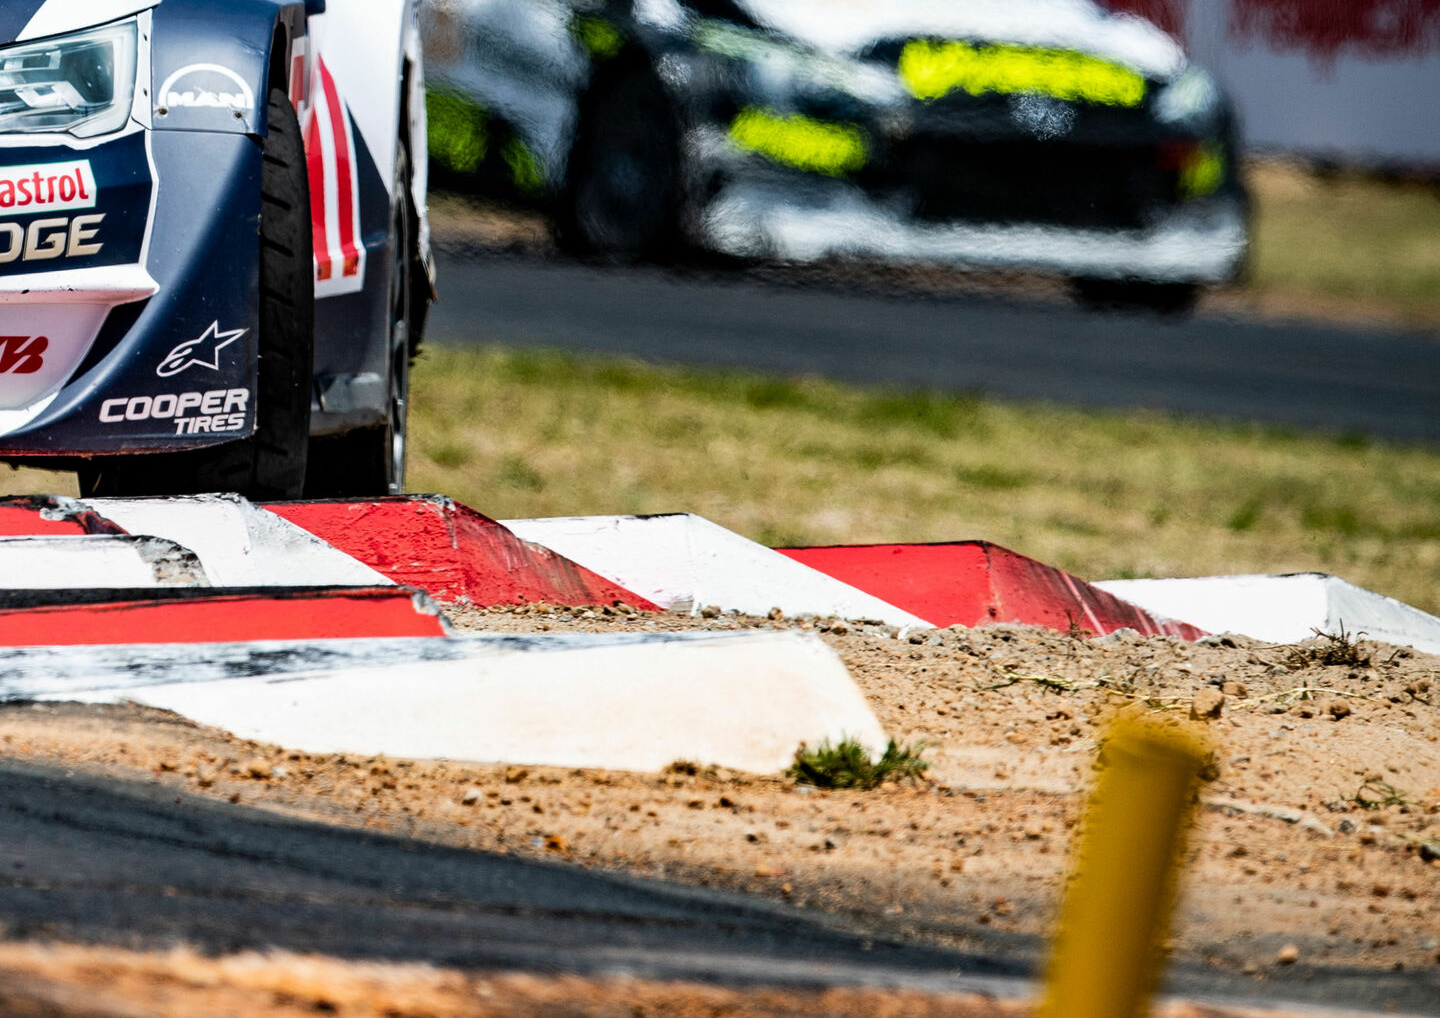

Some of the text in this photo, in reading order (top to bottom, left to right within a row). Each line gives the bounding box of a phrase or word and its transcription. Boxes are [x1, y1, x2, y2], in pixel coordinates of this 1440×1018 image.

[167, 91, 247, 108] MAN
[99, 388, 249, 423] COOPER
[173, 413, 245, 435] TIRES
